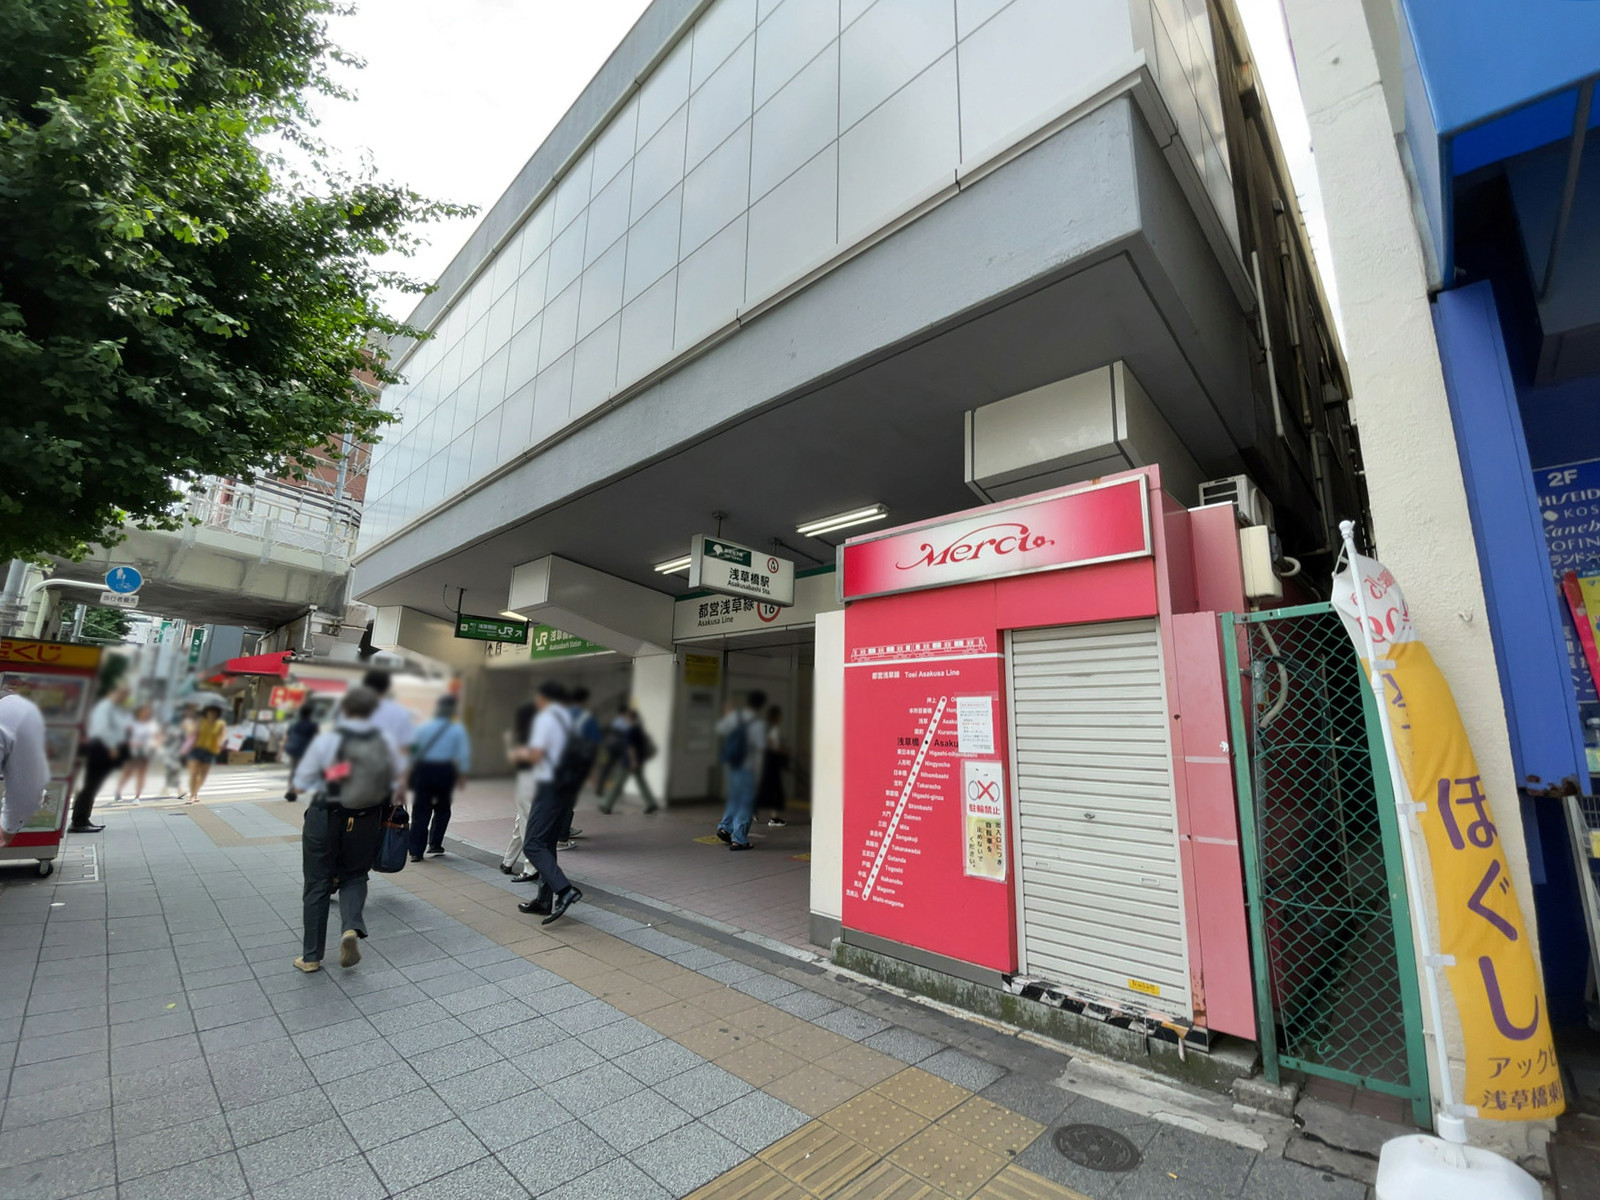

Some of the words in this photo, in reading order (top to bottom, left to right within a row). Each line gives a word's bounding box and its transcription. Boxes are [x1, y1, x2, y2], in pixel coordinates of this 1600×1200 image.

[1547, 469, 1578, 487] 2F
[1548, 537, 1600, 552] OFIN
[729, 567, 770, 588] 浅草橋駅
[727, 580, 761, 594] Asakusabashi
[698, 596, 755, 619] 都営浅草線
[764, 604, 775, 615] 16
[698, 618, 721, 627] Asakusa
[721, 616, 734, 624] Line
[498, 627, 514, 636] JR
[535, 631, 549, 647] JR
[905, 671, 917, 679] Toei
[919, 670, 944, 678] Asakusa
[969, 804, 1001, 815] 駐輪禁止
[985, 821, 993, 853] 自転車を
[1437, 775, 1540, 1041] ほぐし
[1481, 1079, 1564, 1111] 浅草橋東
